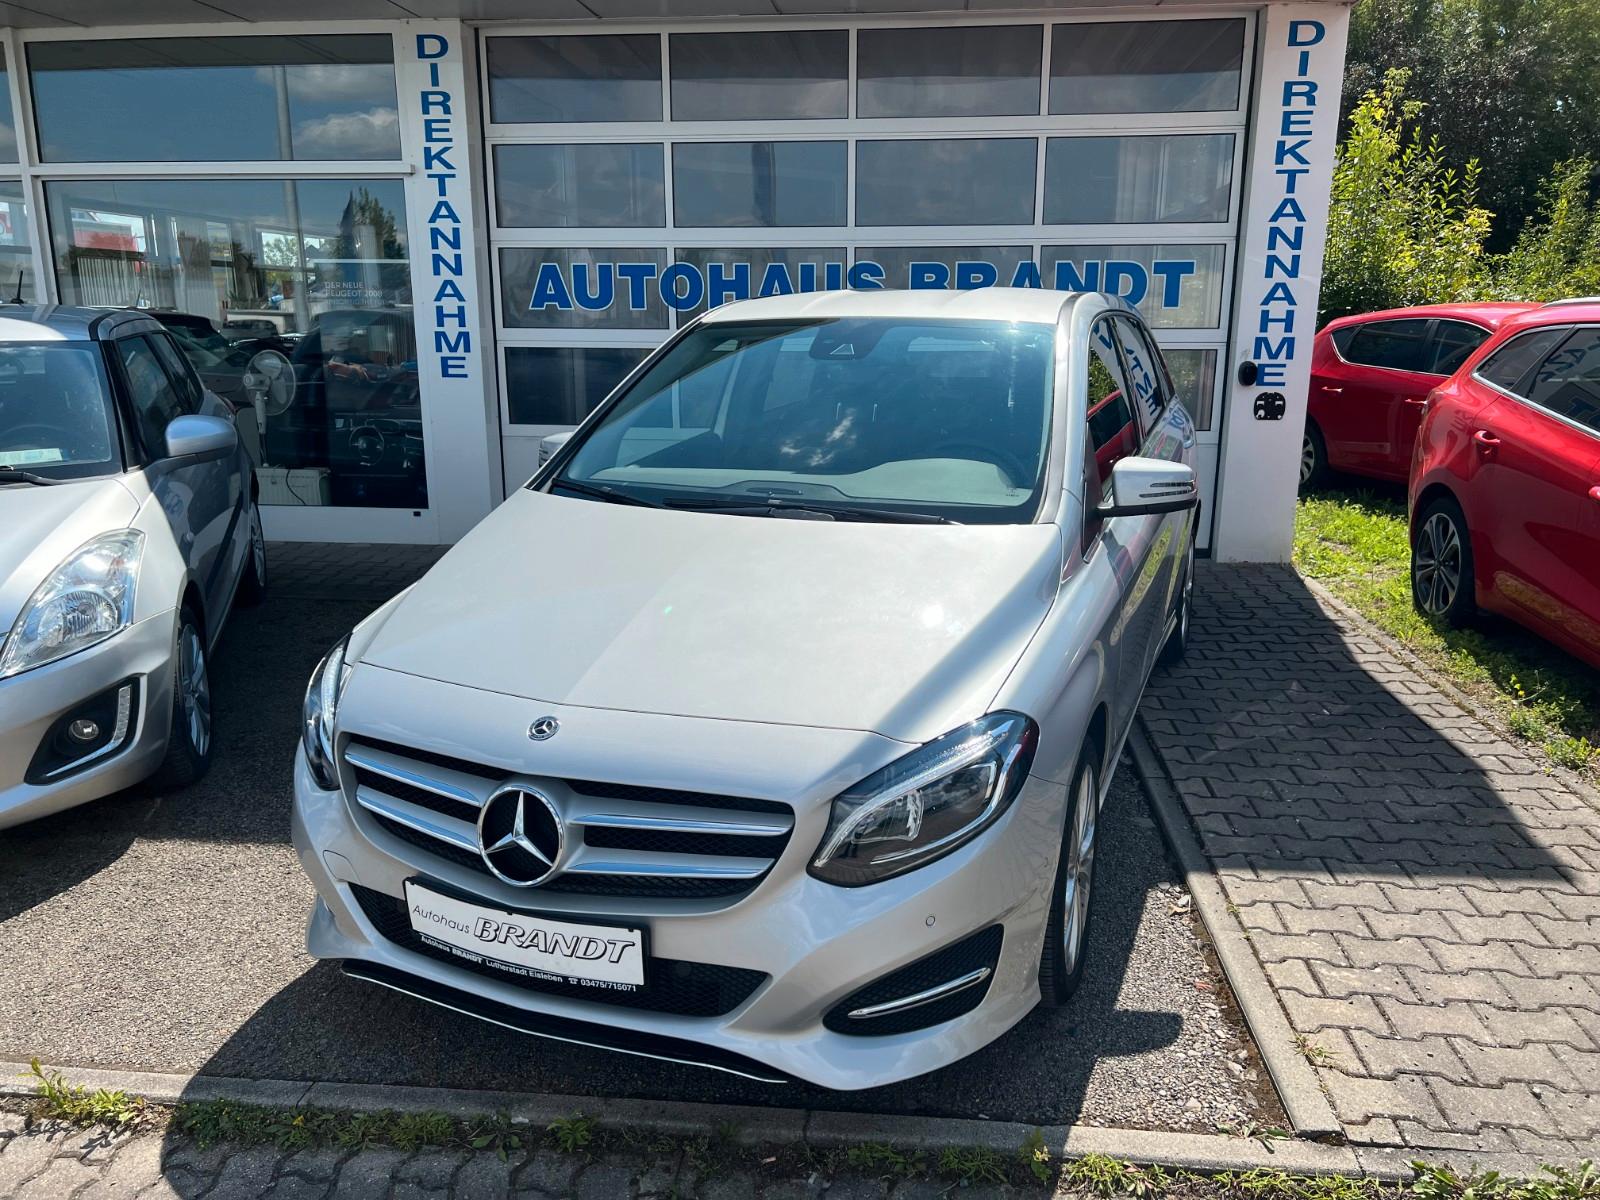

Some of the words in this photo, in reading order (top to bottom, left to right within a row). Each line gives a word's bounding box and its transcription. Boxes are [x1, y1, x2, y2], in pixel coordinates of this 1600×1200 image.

[415, 34, 472, 379] DIREKTANNAHME
[1252, 20, 1326, 387] DIREKTANNAHME
[324, 281, 341, 289] DER
[342, 281, 364, 289] NEUE
[529, 260, 886, 312] AUTOHAUS
[908, 259, 1197, 310] BRANDT
[413, 905, 470, 934] Autohaus
[474, 917, 635, 963] BRANDT
[452, 948, 482, 964] BRANDT
[486, 960, 528, 977] Lutherstadt
[530, 971, 563, 983] Eisleben
[581, 979, 636, 992] 03475/715071
